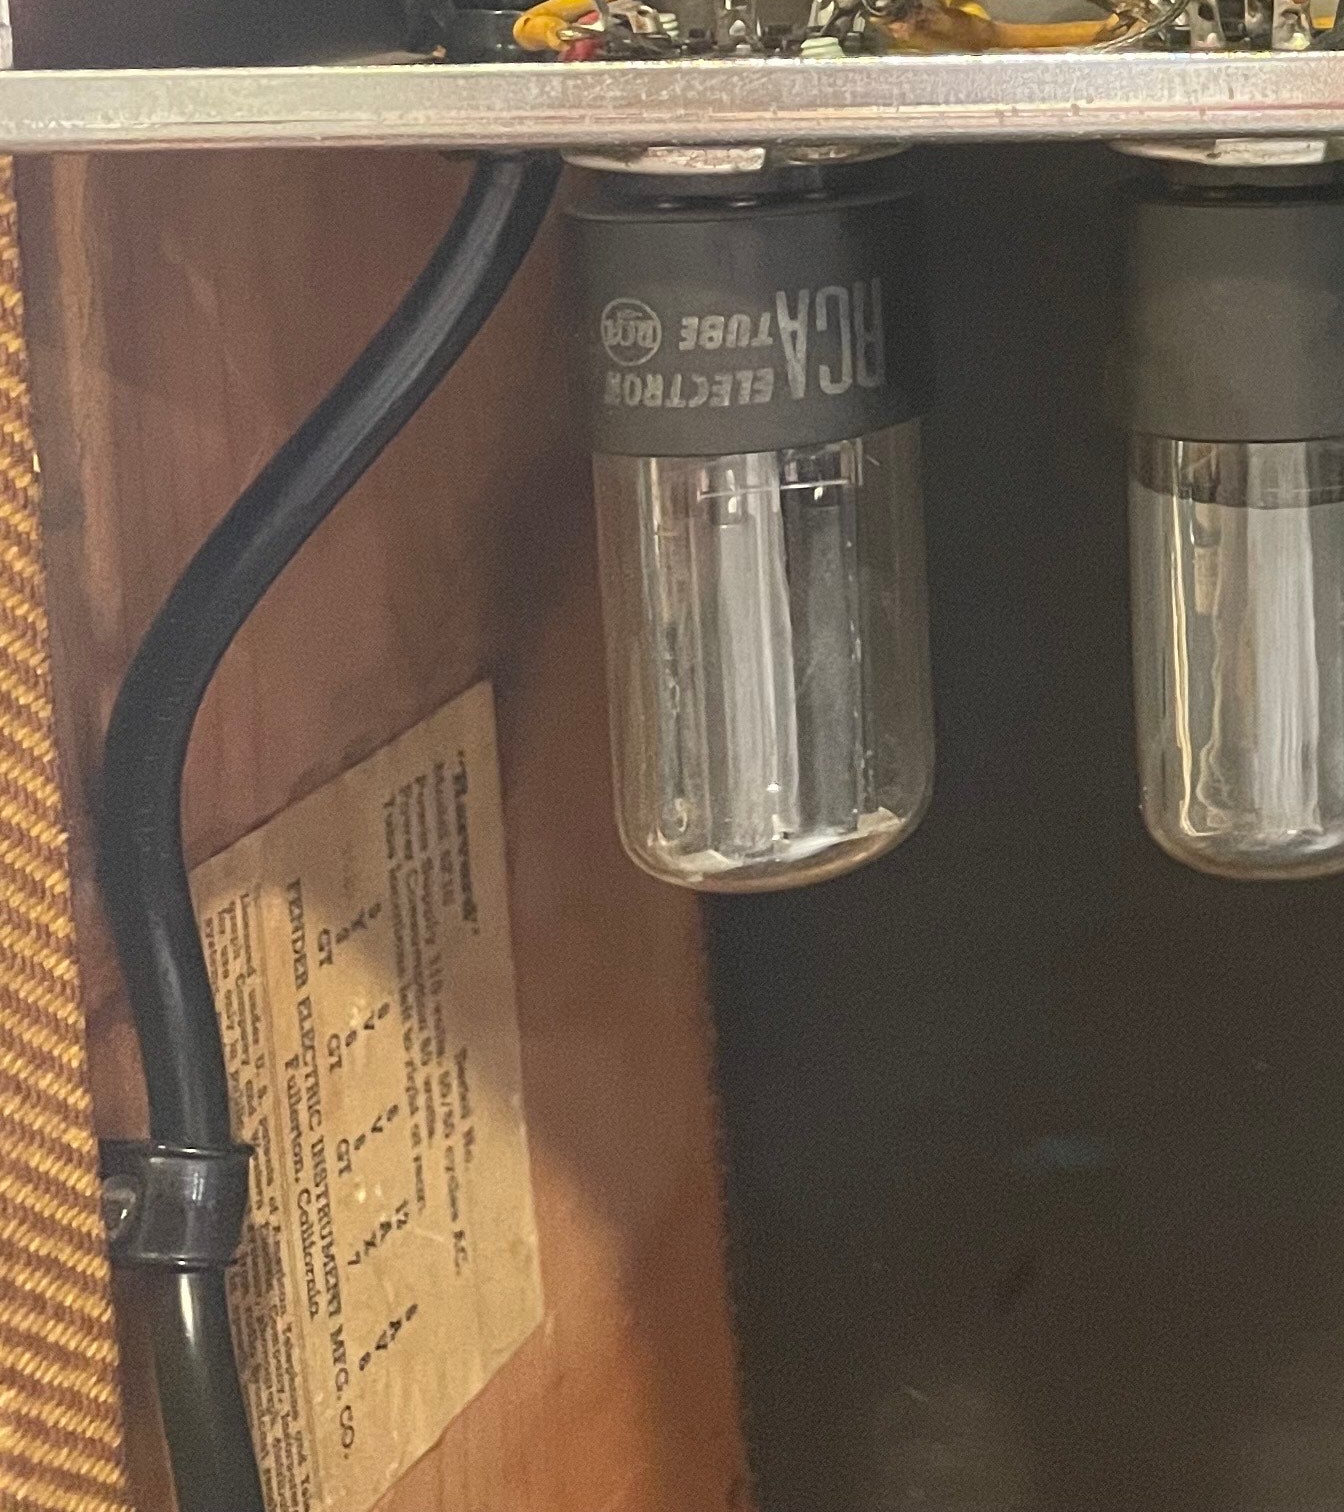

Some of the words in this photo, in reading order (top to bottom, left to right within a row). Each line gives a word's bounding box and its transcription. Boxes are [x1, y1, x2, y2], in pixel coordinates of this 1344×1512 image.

[678, 312, 773, 351] TUBE
[776, 276, 885, 399] RCA
[299, 996, 319, 1131] ELECTRIC
[330, 1322, 348, 1402] MFG.
[339, 1400, 355, 1462] CO.
